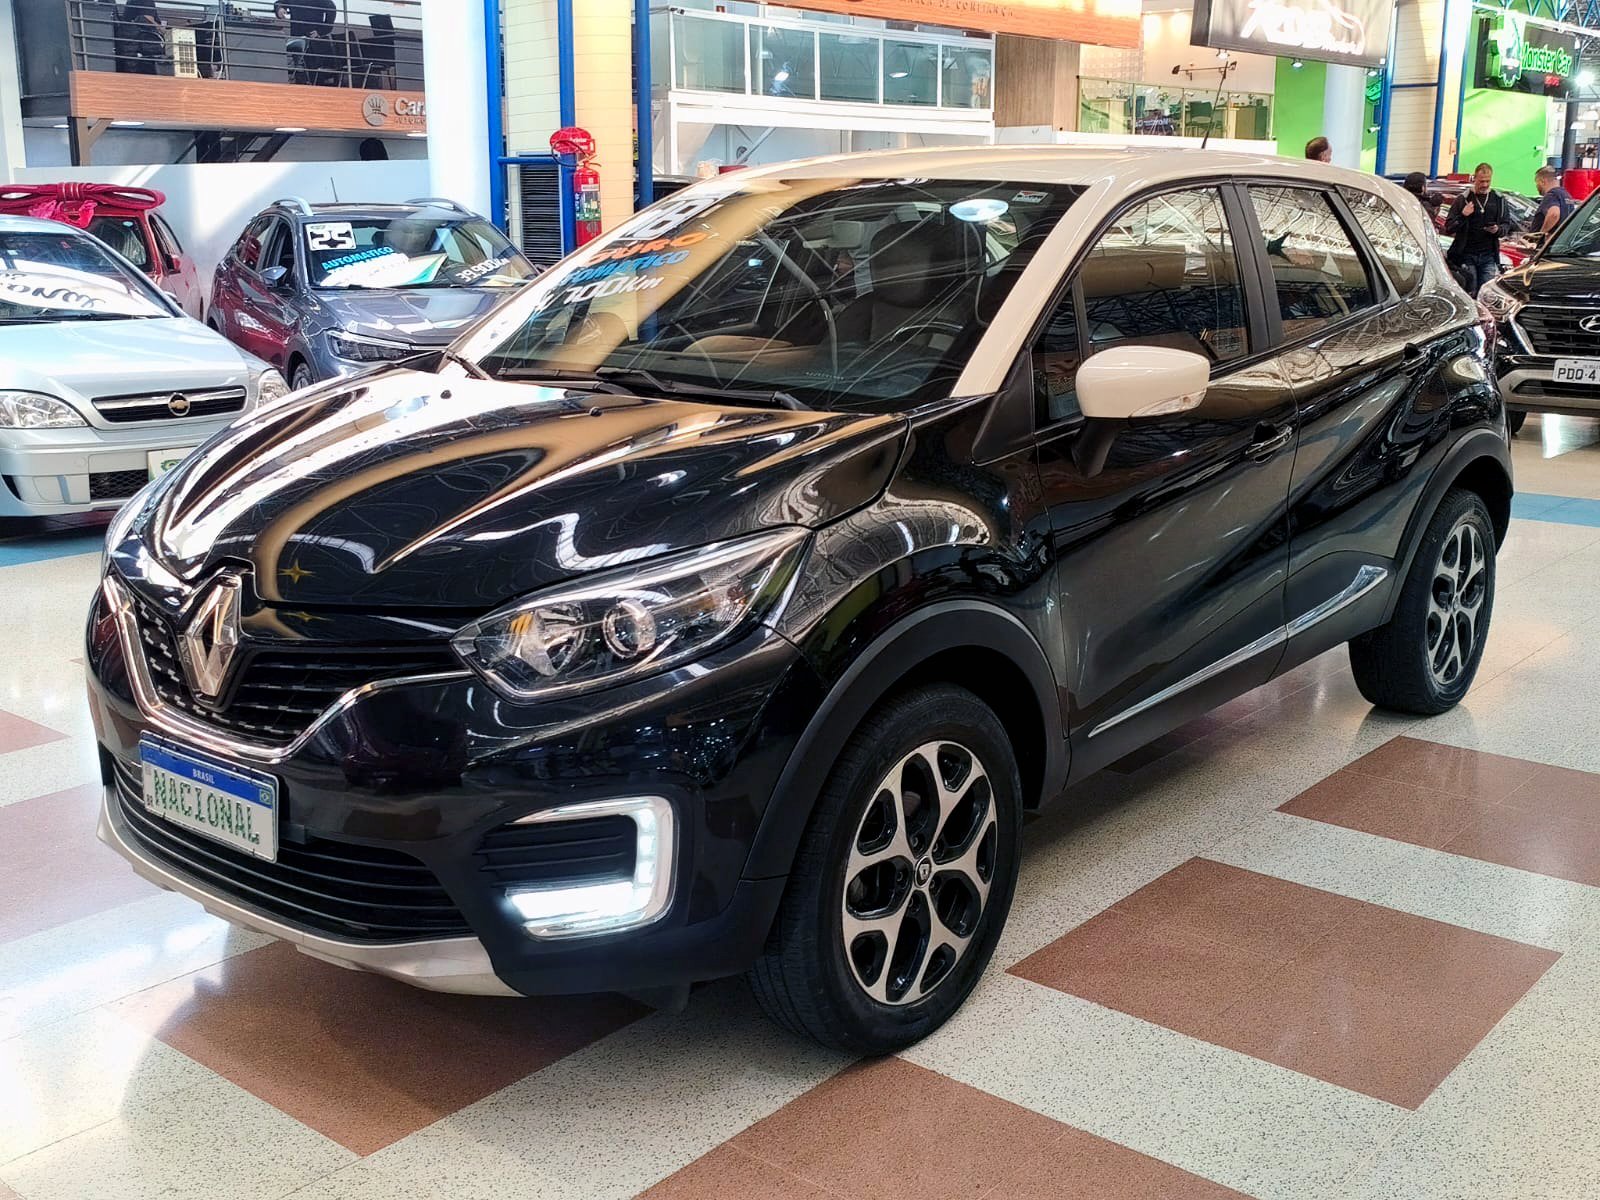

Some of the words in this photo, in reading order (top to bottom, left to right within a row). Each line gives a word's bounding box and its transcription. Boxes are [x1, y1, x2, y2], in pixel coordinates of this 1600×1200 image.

[1521, 42, 1555, 73] Monster
[1556, 47, 1572, 77] Car
[321, 247, 394, 269] AUTOMATICO
[192, 768, 215, 785] BRASIL
[153, 769, 260, 845] NACIONAL
